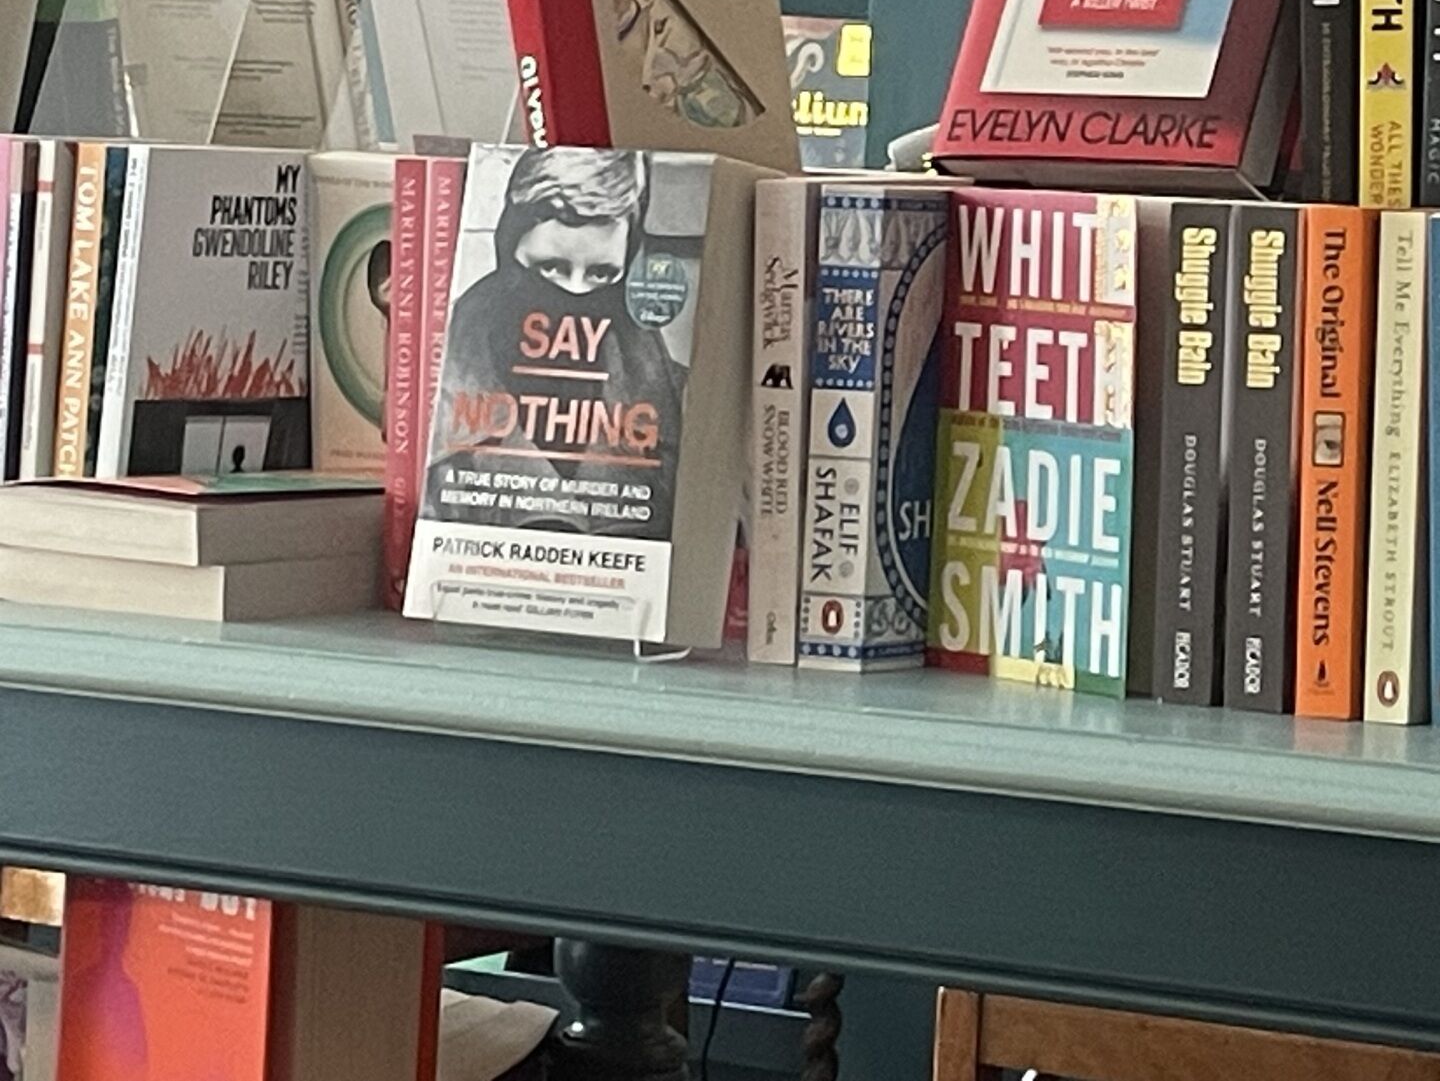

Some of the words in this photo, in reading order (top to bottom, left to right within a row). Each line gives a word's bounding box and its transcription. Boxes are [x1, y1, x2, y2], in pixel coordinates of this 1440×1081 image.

[946, 109, 1071, 143] EVELYN
[1080, 111, 1218, 149] CLARKE
[74, 162, 98, 231] TOM
[276, 164, 300, 192] MY
[211, 195, 298, 226] PHANTOMS
[193, 229, 296, 259] GWENDOLINE
[397, 177, 416, 319] MARILYNNE
[1322, 227, 1346, 281] The
[1396, 233, 1413, 273] Tell
[68, 238, 93, 321] LAKE
[248, 262, 291, 291] RILEY
[822, 288, 875, 308] THERE
[1175, 227, 1216, 326] Shuggie
[1244, 229, 1284, 328] Shuggie
[1395, 280, 1412, 312] Me
[520, 311, 611, 362] SAY
[817, 322, 876, 340] RIVERS
[831, 307, 864, 322] ARE
[1318, 285, 1344, 399] Original
[65, 329, 87, 388] ANN
[816, 338, 838, 352] IN
[842, 339, 873, 357] THE
[828, 355, 863, 373] SKY
[1176, 330, 1212, 386] Bain
[1246, 331, 1281, 390] Bain
[393, 330, 413, 457] ROBINSON
[1384, 321, 1411, 438] Everything
[452, 391, 662, 449] NOTHING
[440, 489, 497, 506] MEMORY
[499, 493, 512, 508] IN
[515, 495, 589, 516] NORTHERN
[591, 501, 652, 521] IRELAND
[445, 469, 455, 483] A
[456, 471, 491, 488] TRUE
[493, 473, 537, 491] STORY
[538, 477, 558, 493] OF
[561, 478, 618, 496] MURDER
[620, 484, 652, 501] AND
[947, 441, 1122, 552] ZADIE
[1182, 434, 1197, 528] DOUGLAS
[1250, 438, 1266, 532] DOUGLAS
[1316, 480, 1340, 534] Nell
[1384, 451, 1401, 562] ELIZABETH
[811, 466, 837, 583] SHAFAK
[839, 502, 860, 556] ELIF
[433, 535, 508, 558] PATRICK
[509, 542, 584, 568] RADDEN
[588, 550, 647, 573] KEEFE
[1178, 534, 1195, 612] STUART
[1248, 538, 1265, 618] STUART
[940, 560, 1123, 678] SMITH
[1312, 536, 1338, 646] Stevens
[1380, 571, 1397, 652] STROUT
